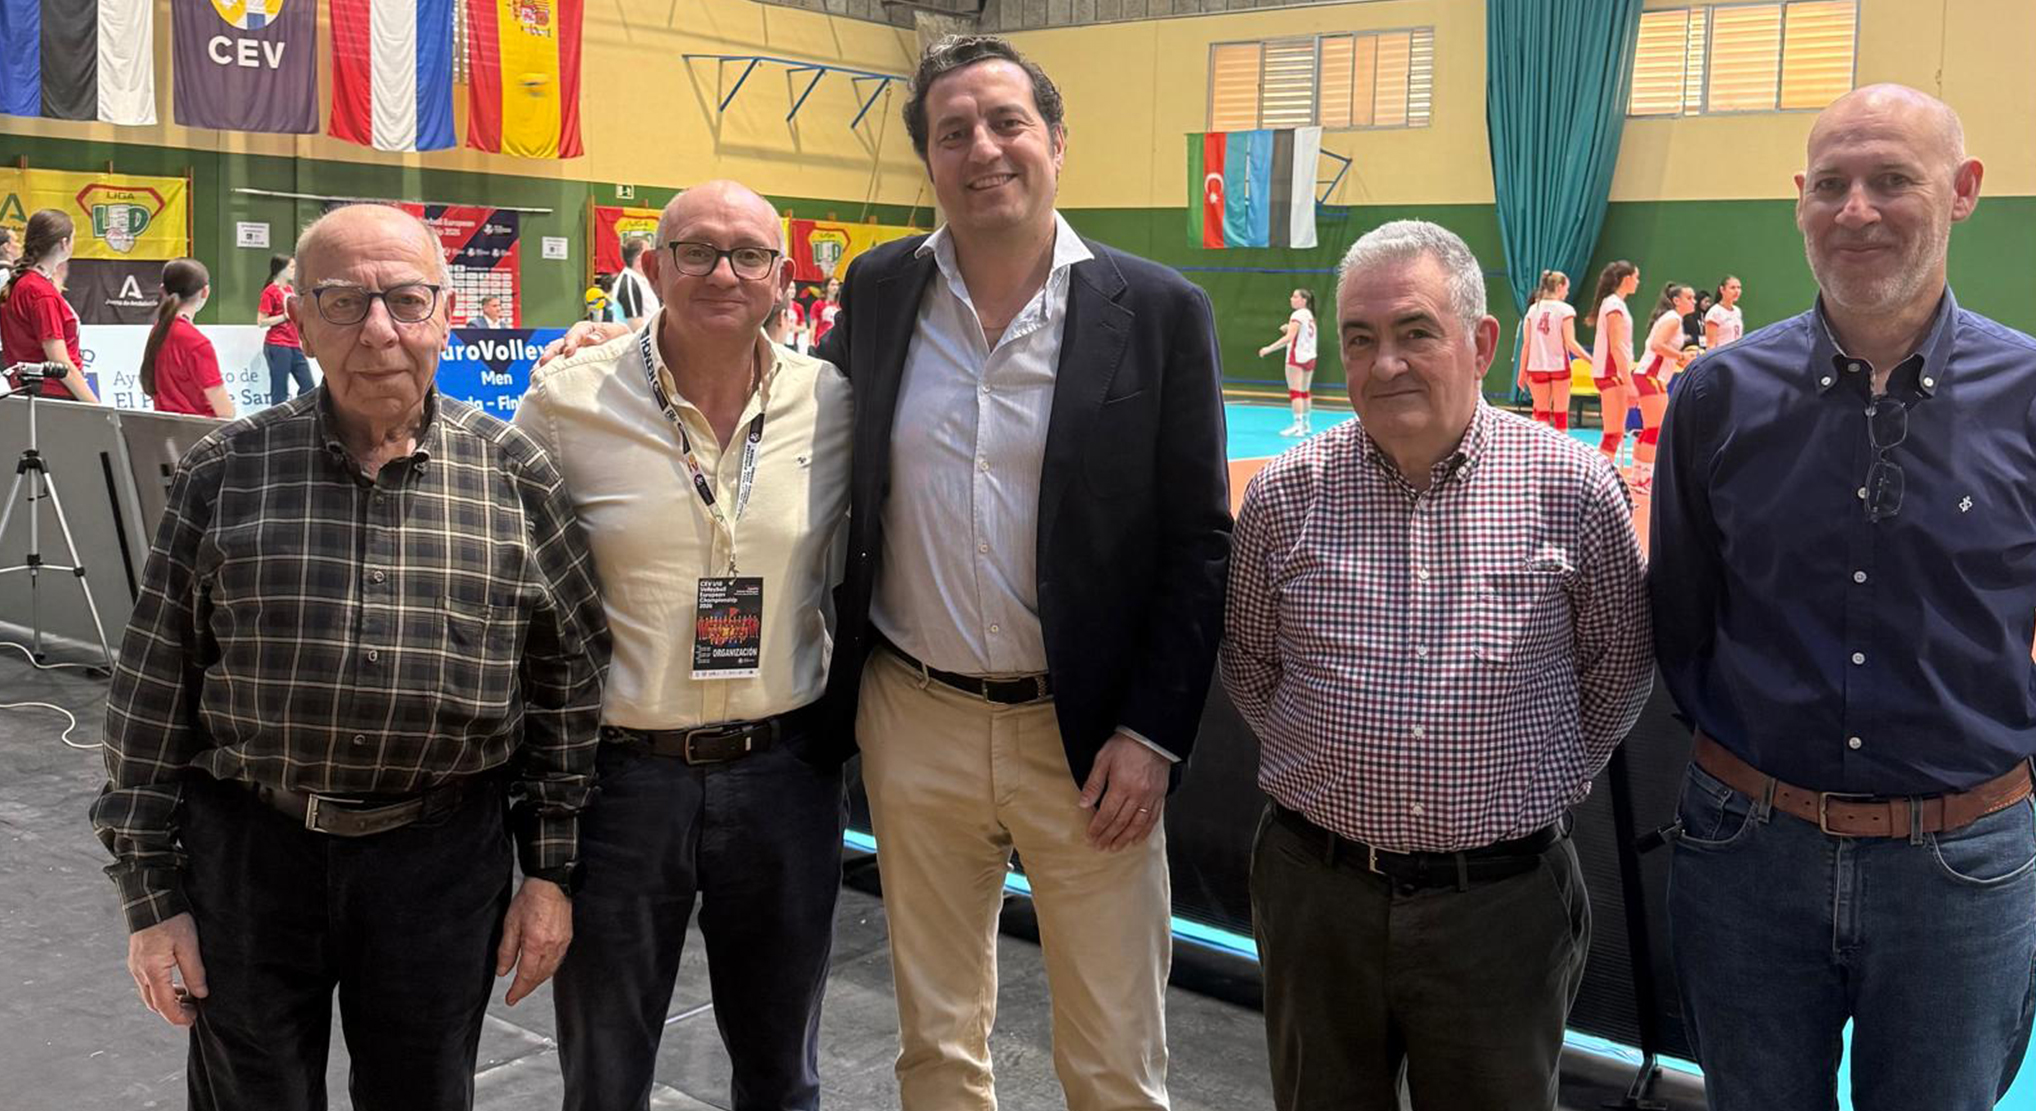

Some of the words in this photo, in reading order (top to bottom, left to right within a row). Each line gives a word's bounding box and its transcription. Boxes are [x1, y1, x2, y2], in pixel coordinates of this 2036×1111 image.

[208, 35, 286, 69] CEV
[106, 191, 135, 200] LIGA
[1537, 312, 1550, 336] 4
[441, 339, 545, 361] uroVolle
[240, 367, 258, 382] de
[481, 371, 513, 385] Men
[113, 392, 135, 408] El
